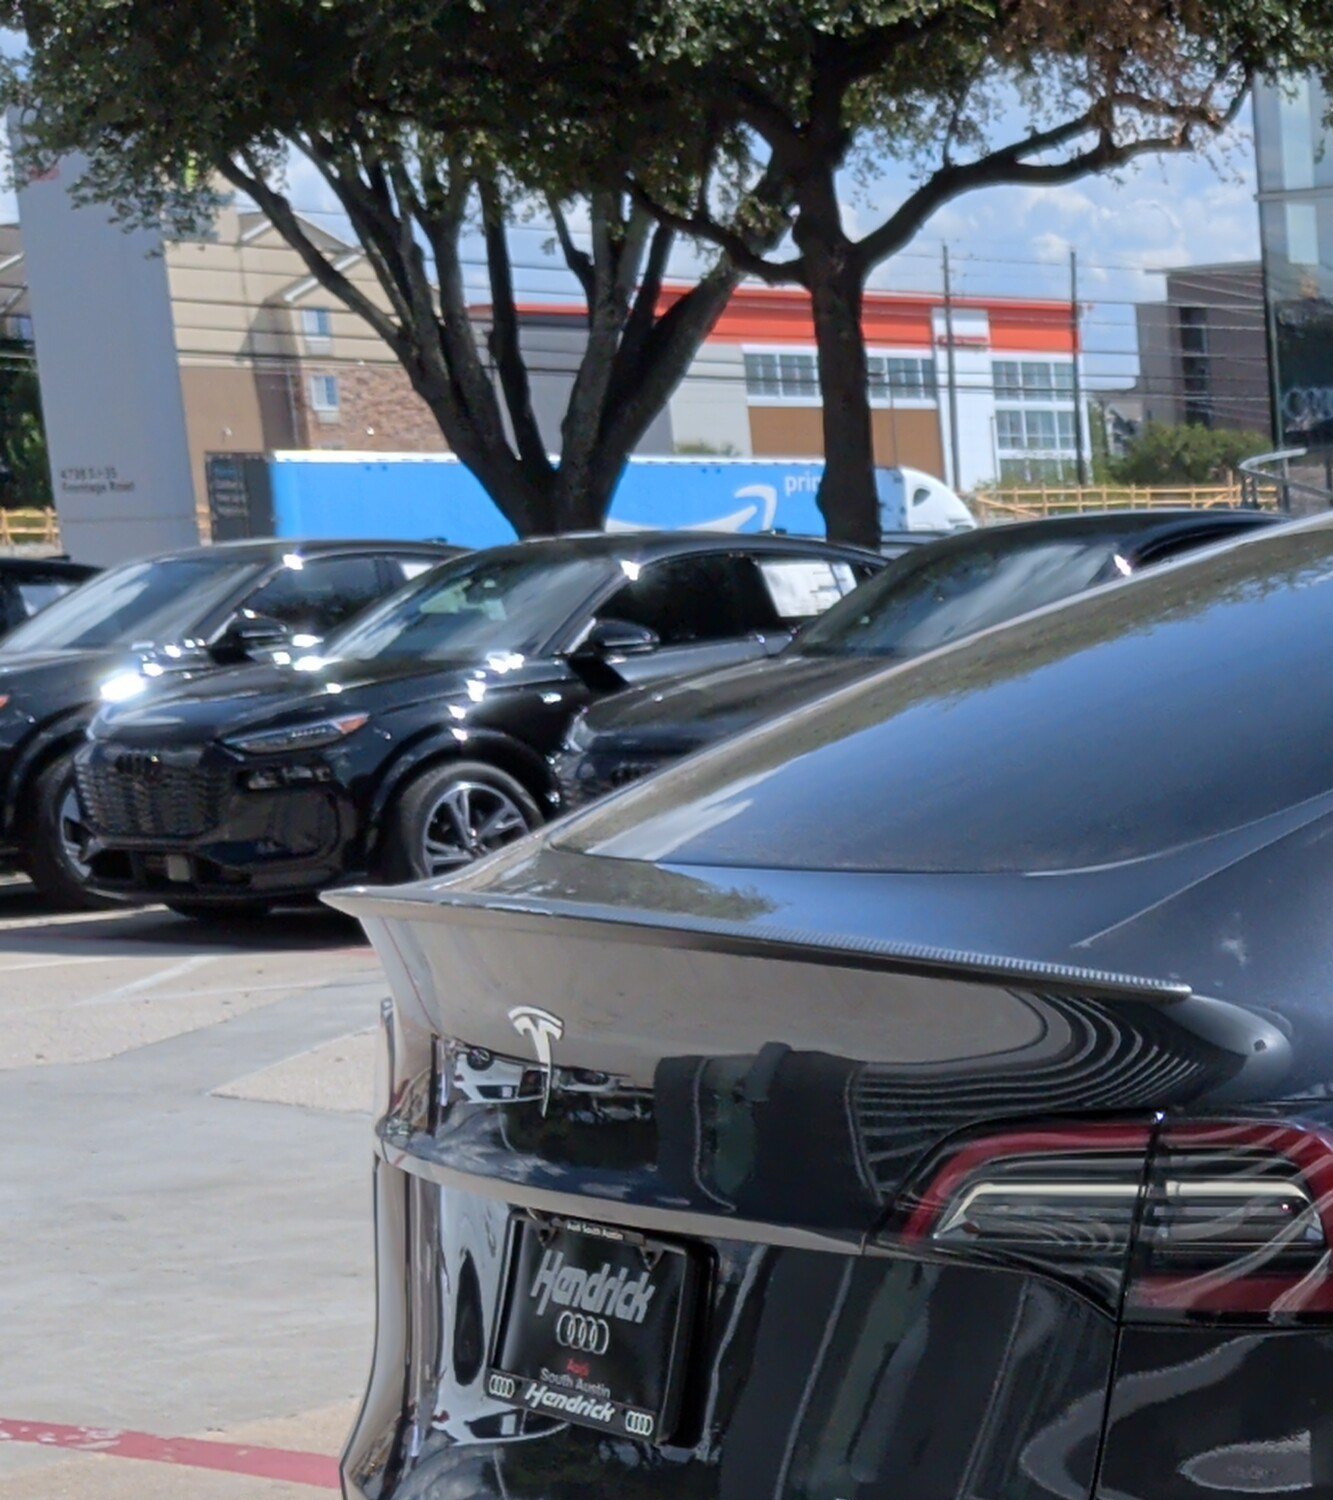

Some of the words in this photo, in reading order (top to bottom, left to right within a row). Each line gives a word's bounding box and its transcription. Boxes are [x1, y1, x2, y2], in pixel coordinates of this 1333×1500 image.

[530, 1249, 656, 1324] Hendrick
[540, 1367, 574, 1388] South
[575, 1378, 611, 1399] Austin
[566, 1358, 590, 1377] Audi
[524, 1382, 616, 1423] Hendrick
